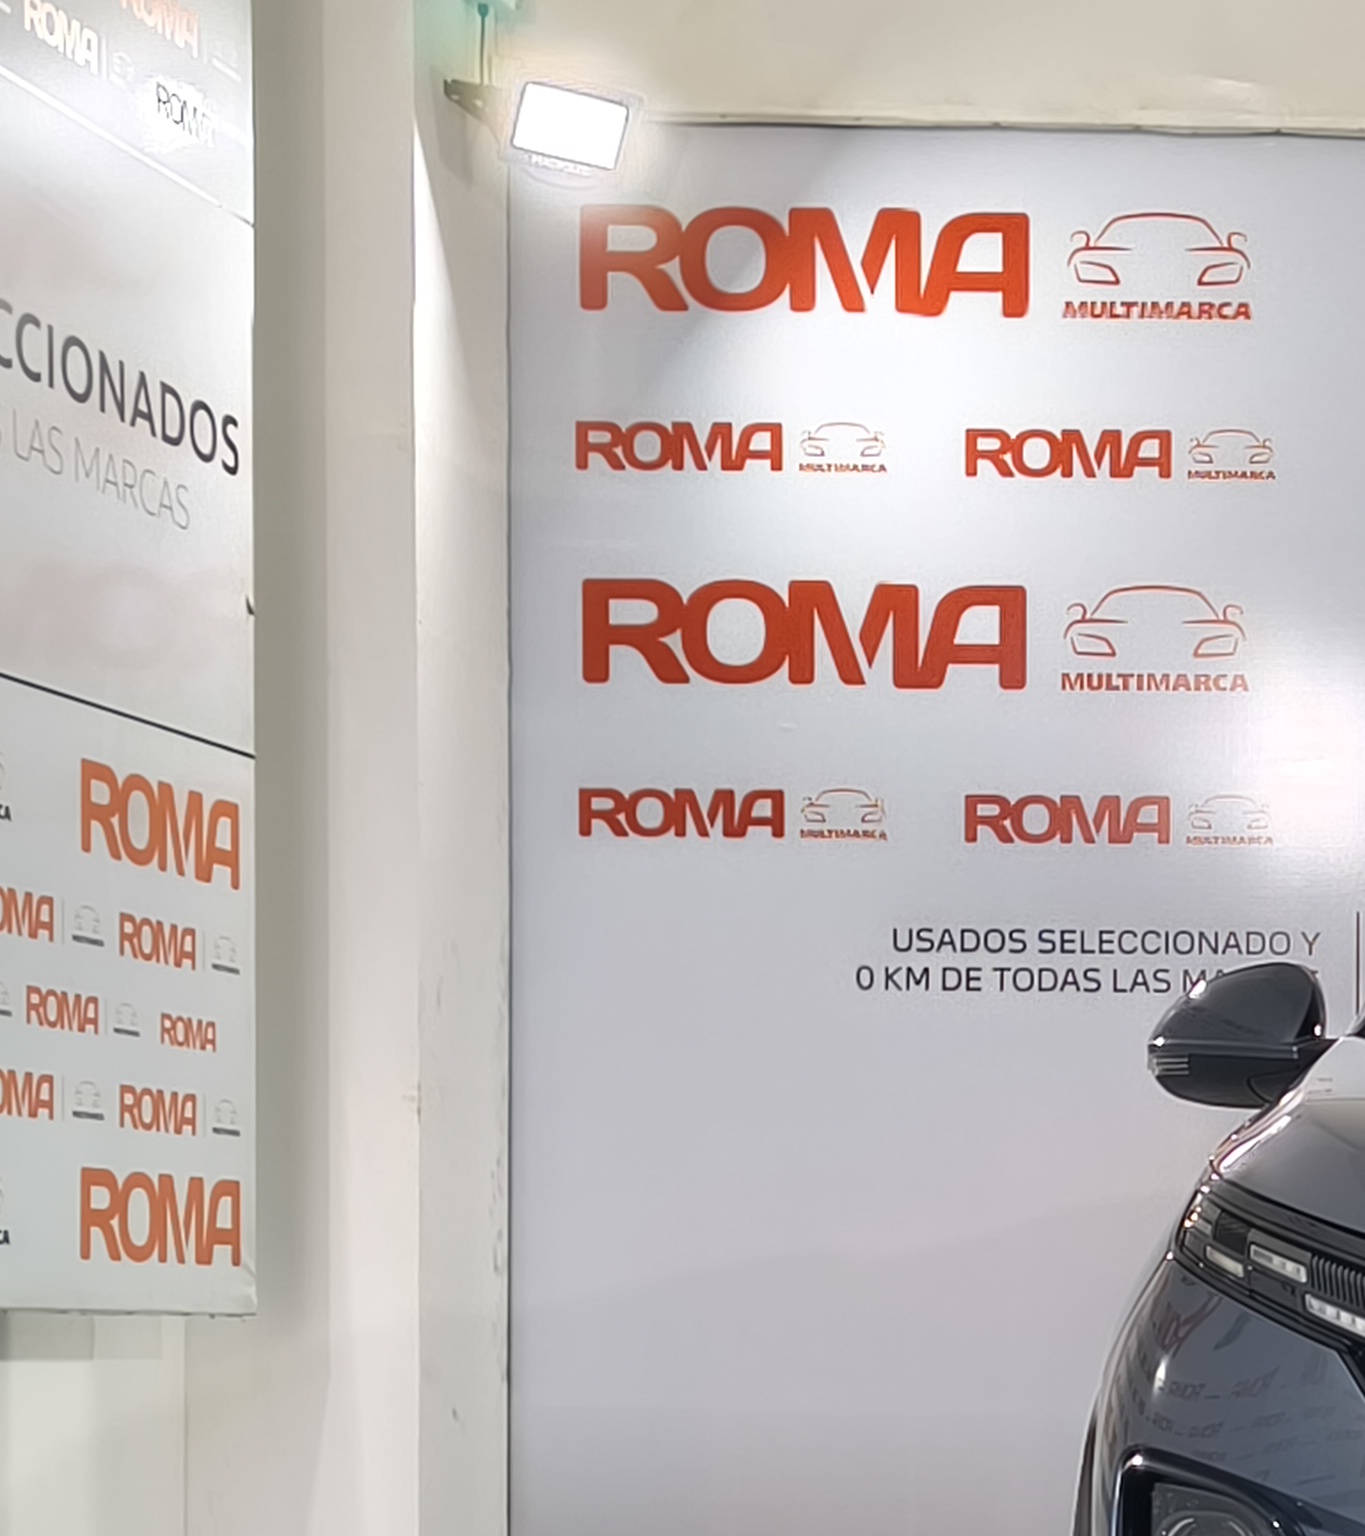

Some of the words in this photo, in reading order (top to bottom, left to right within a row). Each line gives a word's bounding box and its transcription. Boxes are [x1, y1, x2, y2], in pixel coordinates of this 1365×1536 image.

[120, 0, 198, 58] OMA
[578, 206, 1031, 319] ROMA
[1062, 301, 1253, 322] MULTIMARCA
[13, 409, 64, 475] LAS
[74, 437, 190, 530] MARCAS
[574, 421, 784, 472] ROMA
[964, 428, 1173, 478] ROMA
[581, 579, 1027, 691] ROMA
[1061, 672, 1249, 692] MULTIMARCA
[80, 759, 242, 891] ROMA
[578, 788, 786, 839] ROMA
[965, 794, 1172, 845] ROMA
[119, 913, 197, 971] ROMA
[892, 928, 1027, 955] USADOS
[1038, 928, 1290, 956] SELECCIONADO
[1301, 931, 1321, 956] Y
[885, 966, 930, 992] KM
[942, 967, 983, 992] DE
[992, 967, 1101, 993] TODAS
[1112, 968, 1172, 994] LAS
[25, 985, 99, 1035] ROMA
[160, 1013, 217, 1053] ROMA
[119, 1084, 198, 1137] ROMA
[80, 1167, 242, 1267] ROMA
